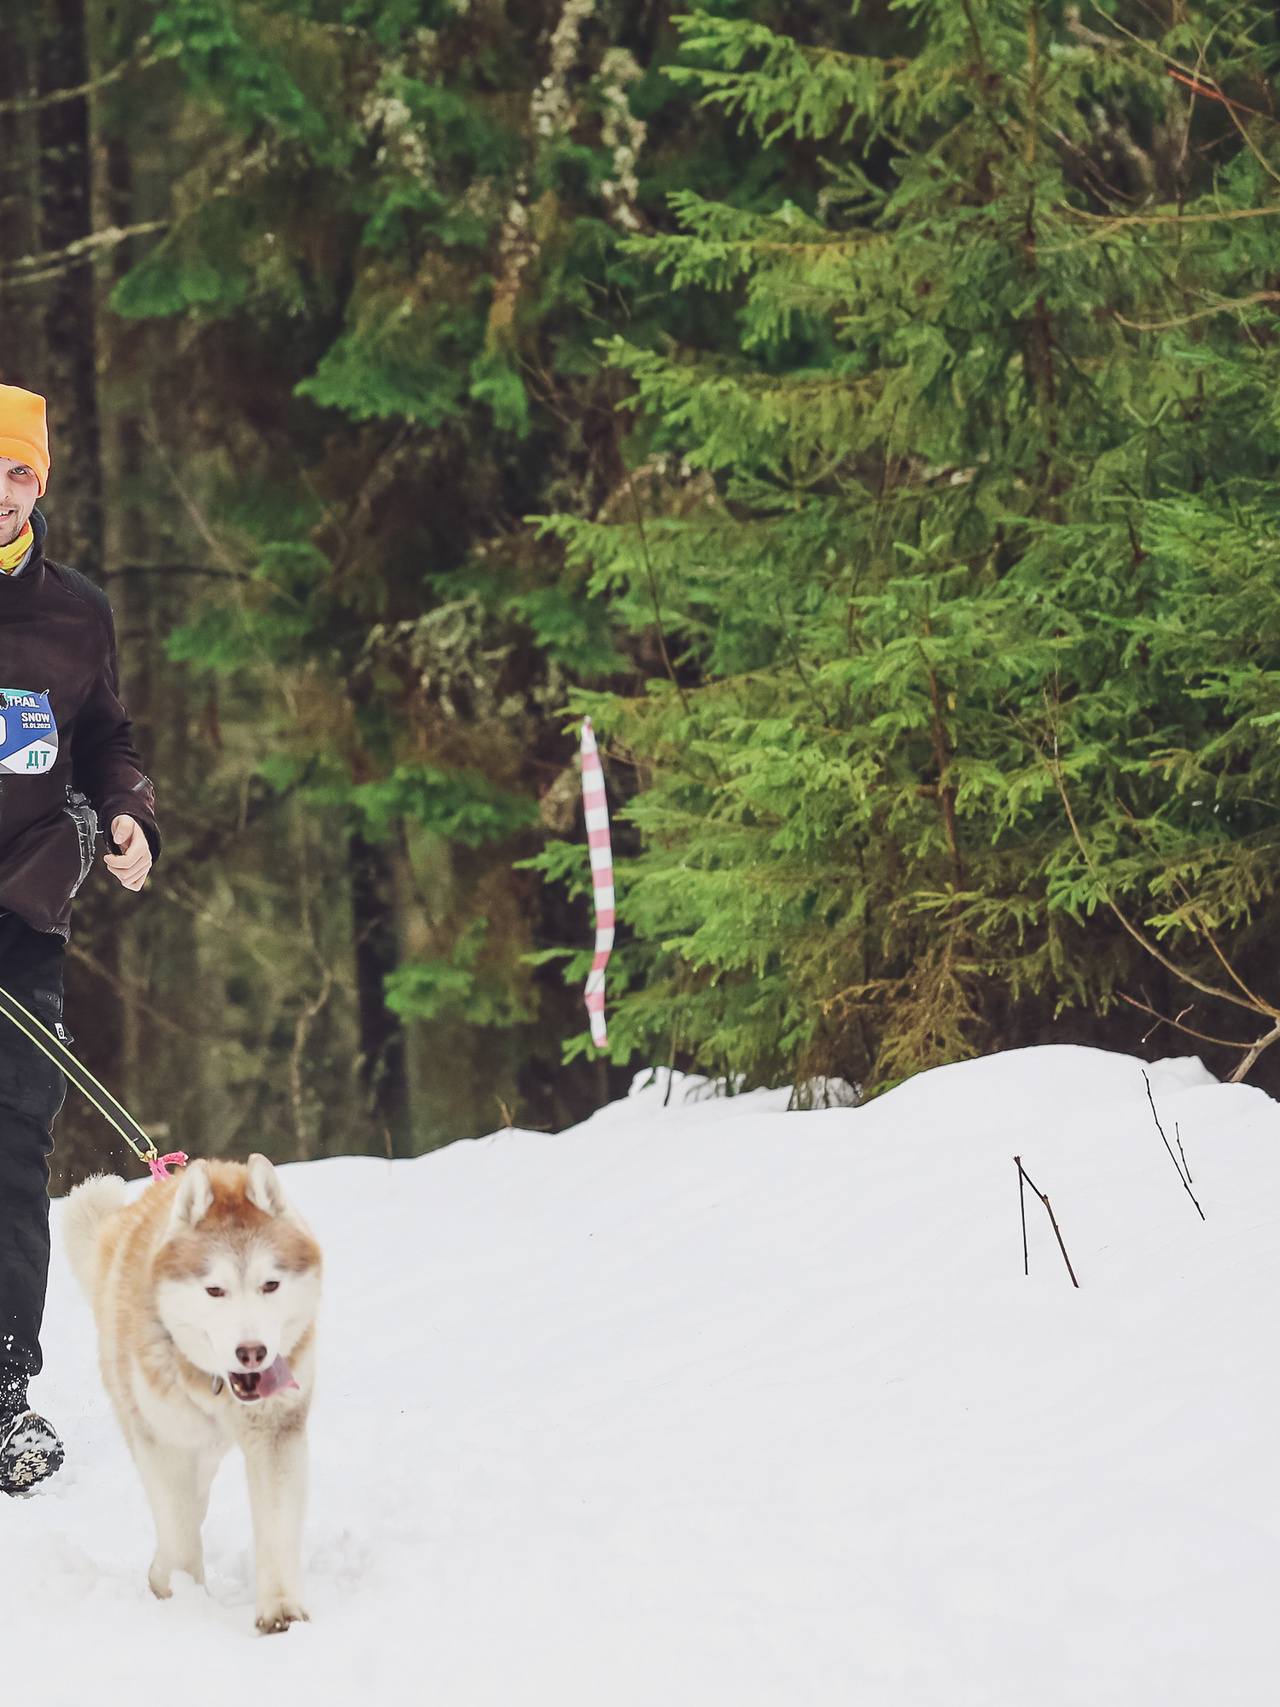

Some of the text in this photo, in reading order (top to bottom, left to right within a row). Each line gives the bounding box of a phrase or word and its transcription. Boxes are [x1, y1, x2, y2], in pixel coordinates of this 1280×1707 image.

[7, 695, 40, 708] TRAIL
[21, 712, 50, 723] SNOW
[26, 750, 50, 769] ДТ
